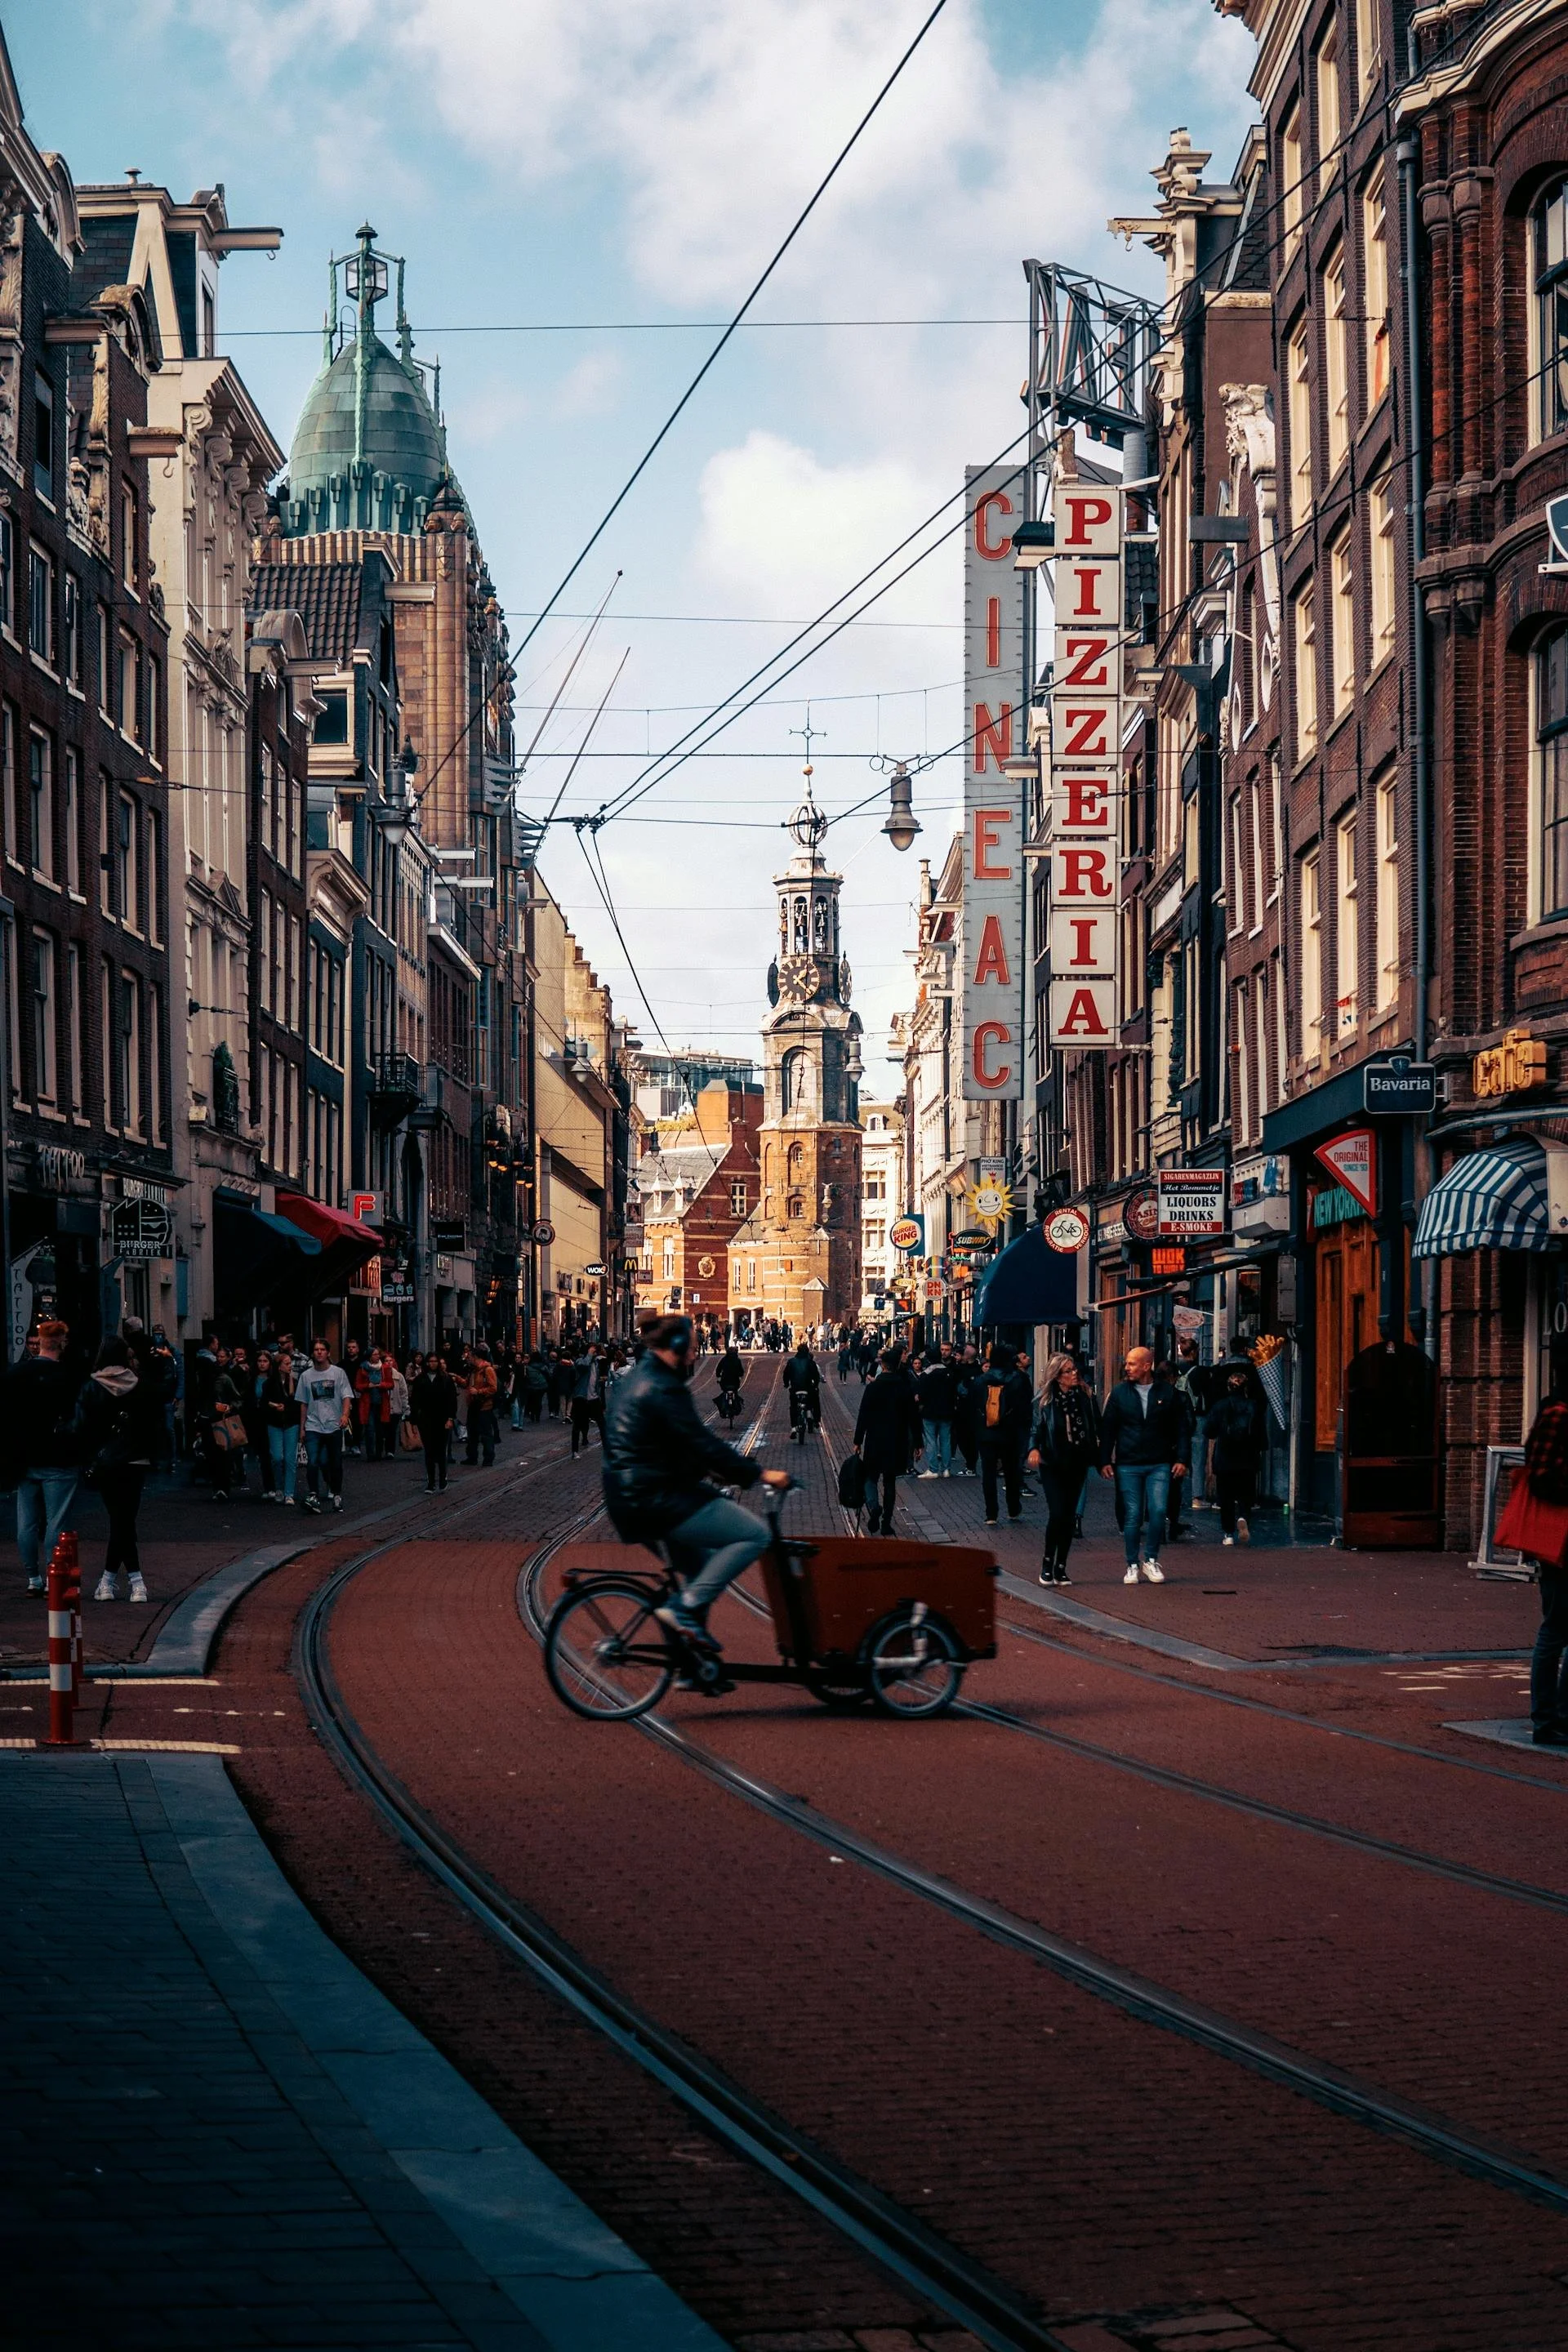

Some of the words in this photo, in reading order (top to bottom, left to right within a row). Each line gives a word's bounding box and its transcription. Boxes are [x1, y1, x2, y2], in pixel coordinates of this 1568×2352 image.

[1058, 497, 1114, 1036] PIZZERIA
[973, 491, 1014, 1089] CINEAC
[1370, 1076, 1431, 1092] Bavaria
[1354, 1141, 1368, 1152] THE
[1334, 1152, 1368, 1162] ORIGINAL
[1343, 1163, 1359, 1171] SINCE
[354, 1194, 376, 1220] F
[1167, 1196, 1216, 1208] LIQUORS
[1314, 1189, 1333, 1228] NEW
[1169, 1210, 1214, 1222] DRINKS
[893, 1225, 916, 1236] BURGER
[1171, 1223, 1213, 1232] E-SMOKE
[893, 1231, 917, 1244] KING
[956, 1236, 990, 1245] SUBWAY
[1045, 1225, 1064, 1253] REPARATIE
[1074, 1223, 1089, 1250] VERKOOP
[120, 1241, 161, 1249] BURGER
[383, 1295, 415, 1304] Burgers
[12, 1267, 24, 1346] TATTOO
